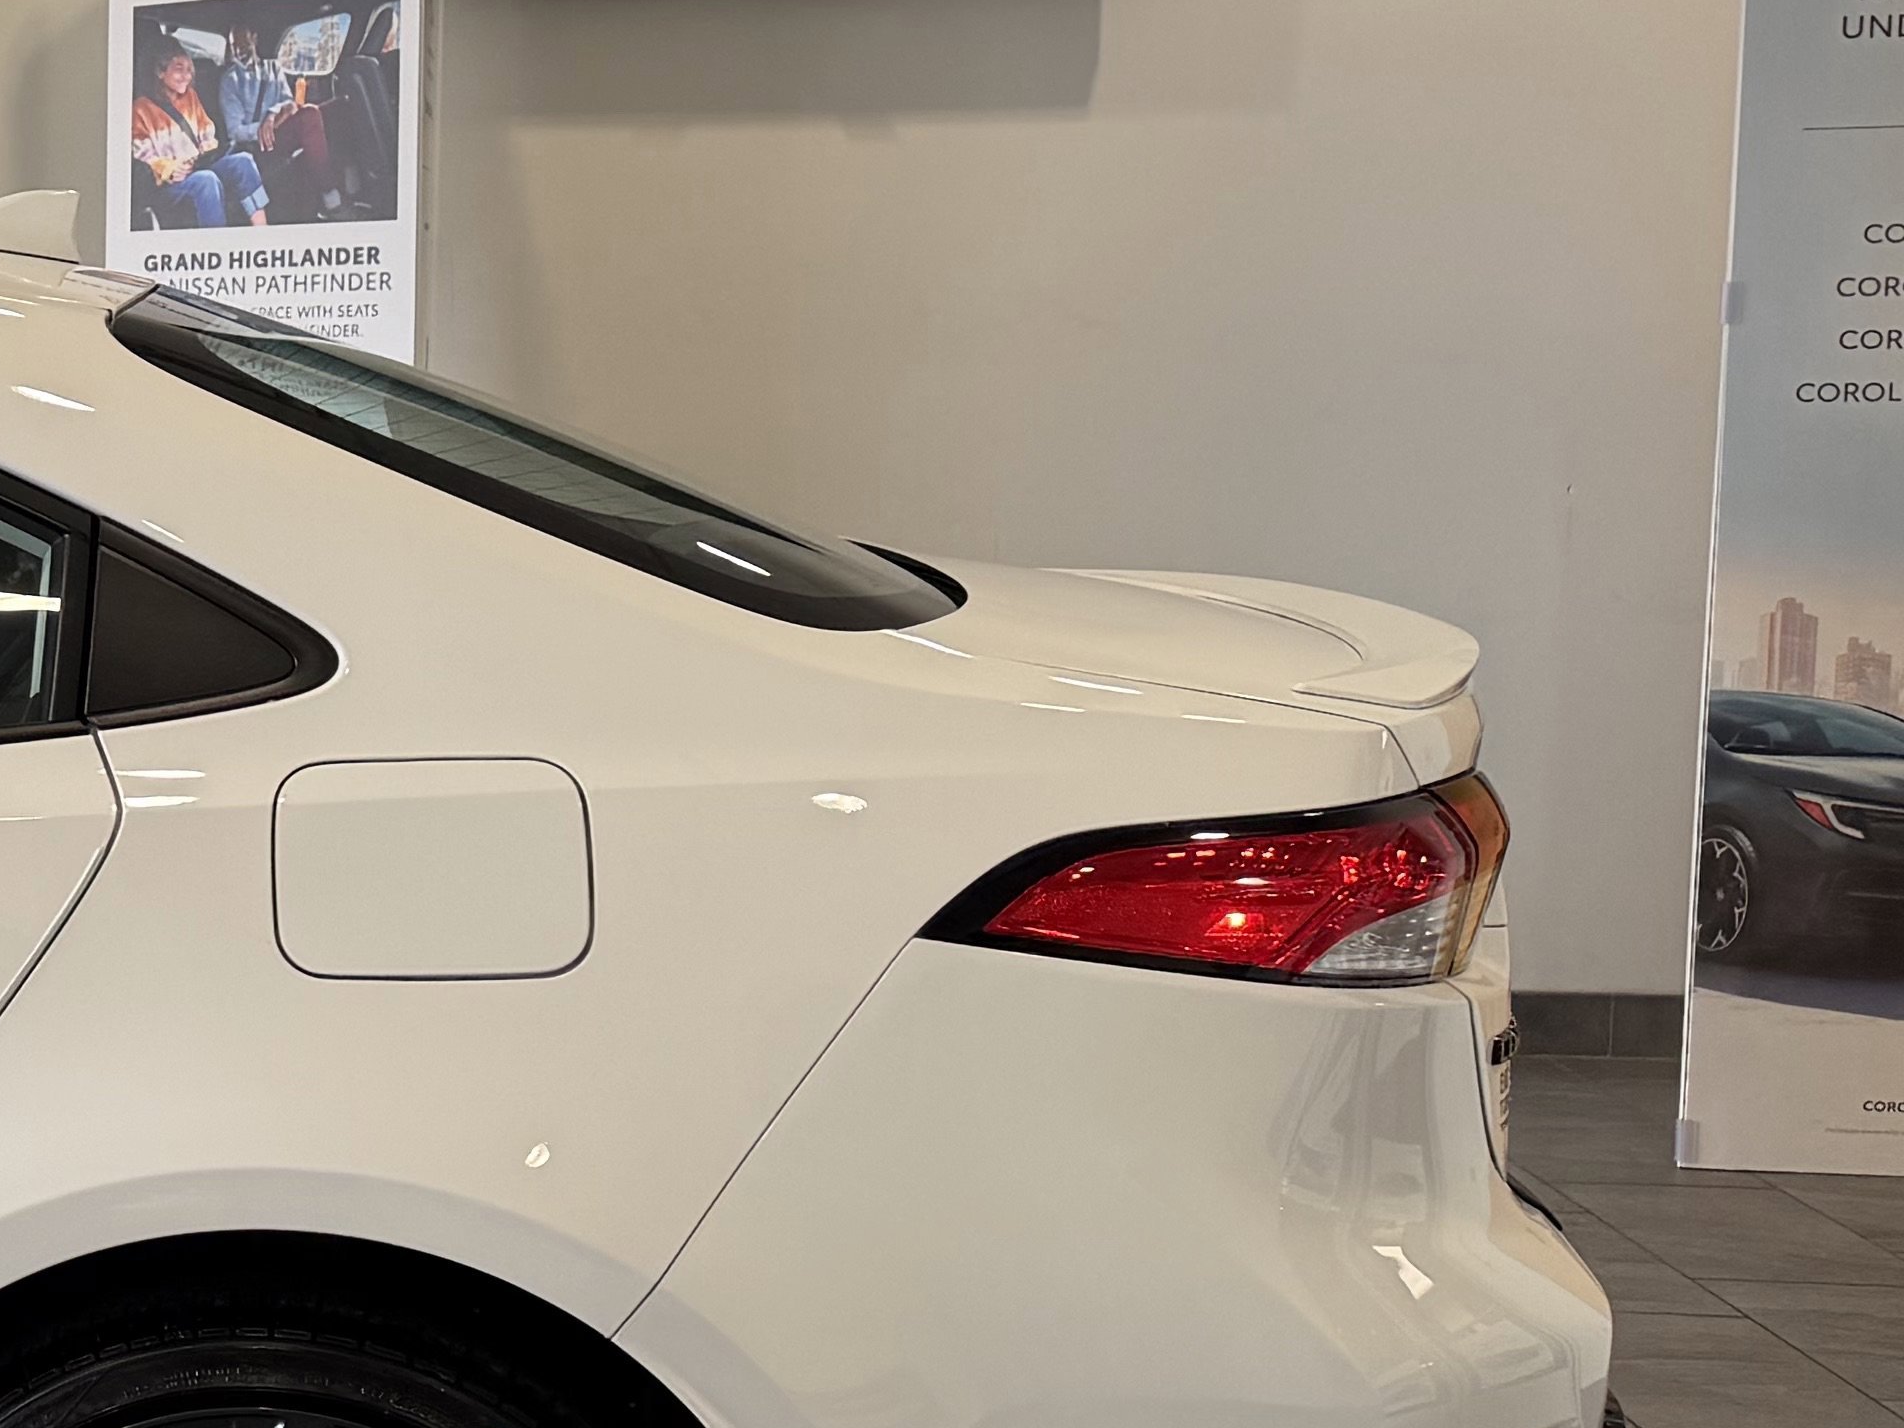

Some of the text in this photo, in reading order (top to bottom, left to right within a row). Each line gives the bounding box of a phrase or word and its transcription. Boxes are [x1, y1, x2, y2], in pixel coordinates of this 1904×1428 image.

[1842, 14, 1904, 39] UN
[144, 246, 381, 272] GRAND HIGHLANDER
[255, 272, 392, 295] PATHFINDER
[1837, 276, 1904, 297] COR
[297, 305, 333, 319] WITH
[337, 303, 379, 318] SEATS
[1839, 329, 1903, 350] COR
